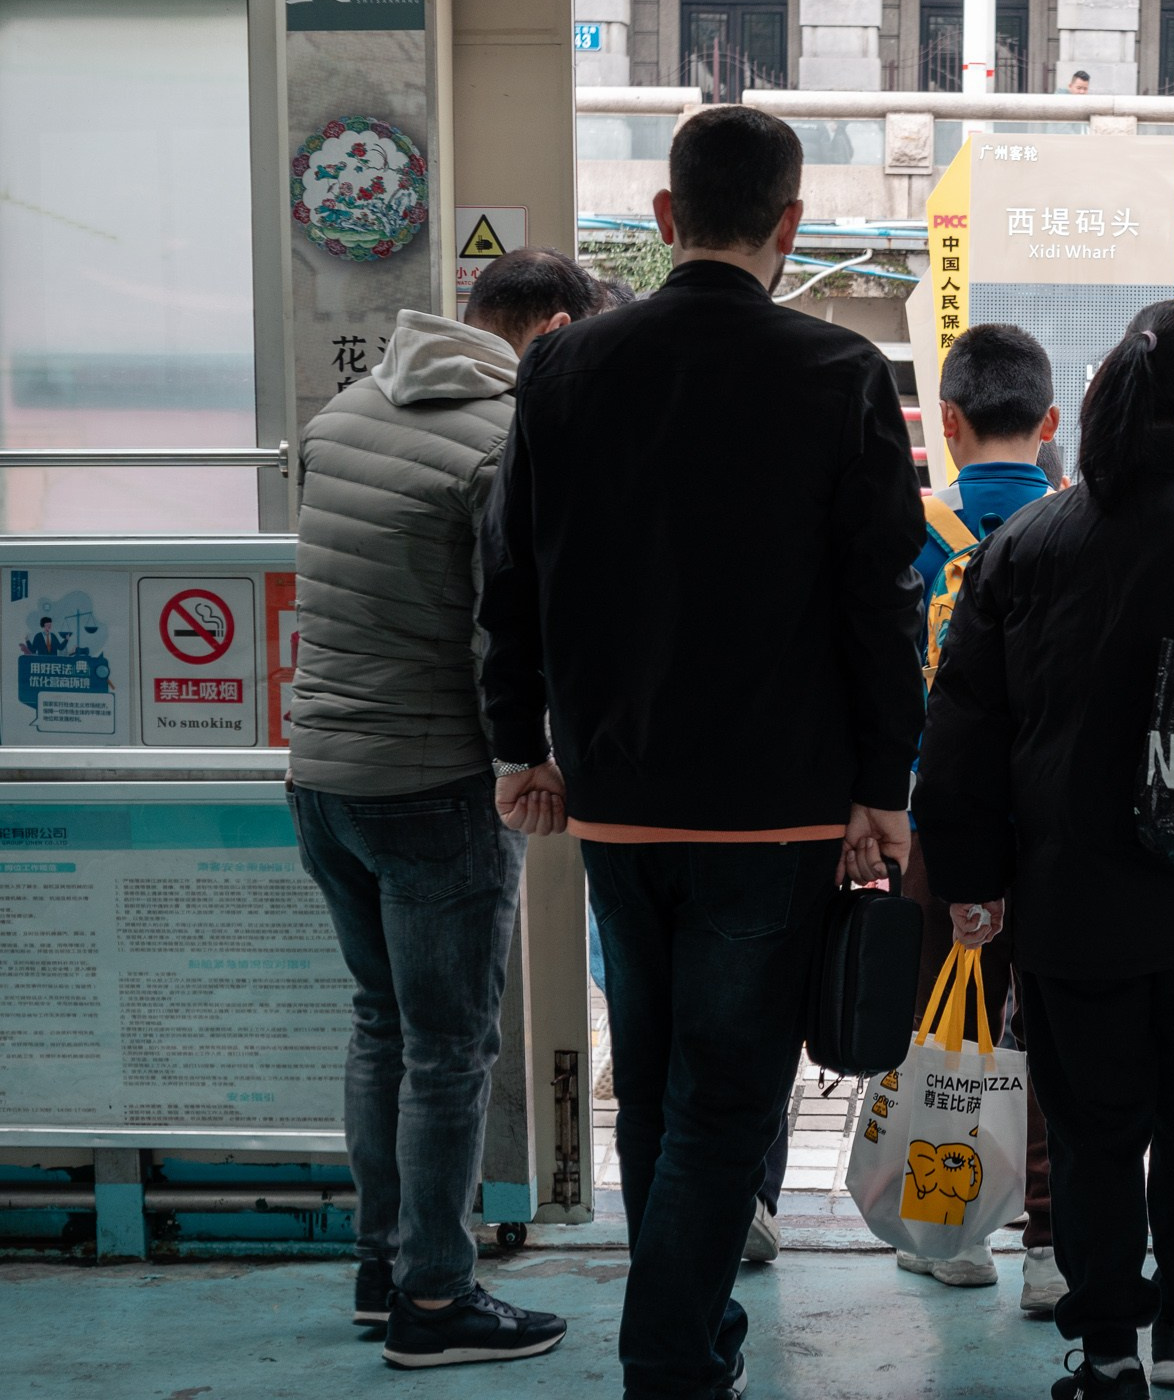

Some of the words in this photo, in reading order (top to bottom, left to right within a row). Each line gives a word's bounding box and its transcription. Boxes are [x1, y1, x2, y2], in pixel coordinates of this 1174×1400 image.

[979, 145, 1038, 161] 广州客轮
[933, 215, 967, 228] PICC
[1006, 207, 1139, 237] 西堤码头
[1029, 244, 1060, 258] Xidi
[1066, 244, 1116, 259] Wharf
[160, 681, 238, 701] 禁止吸烟
[157, 717, 176, 729] No
[180, 717, 243, 731] smoking
[924, 1090, 980, 1114] 尊宝比萨
